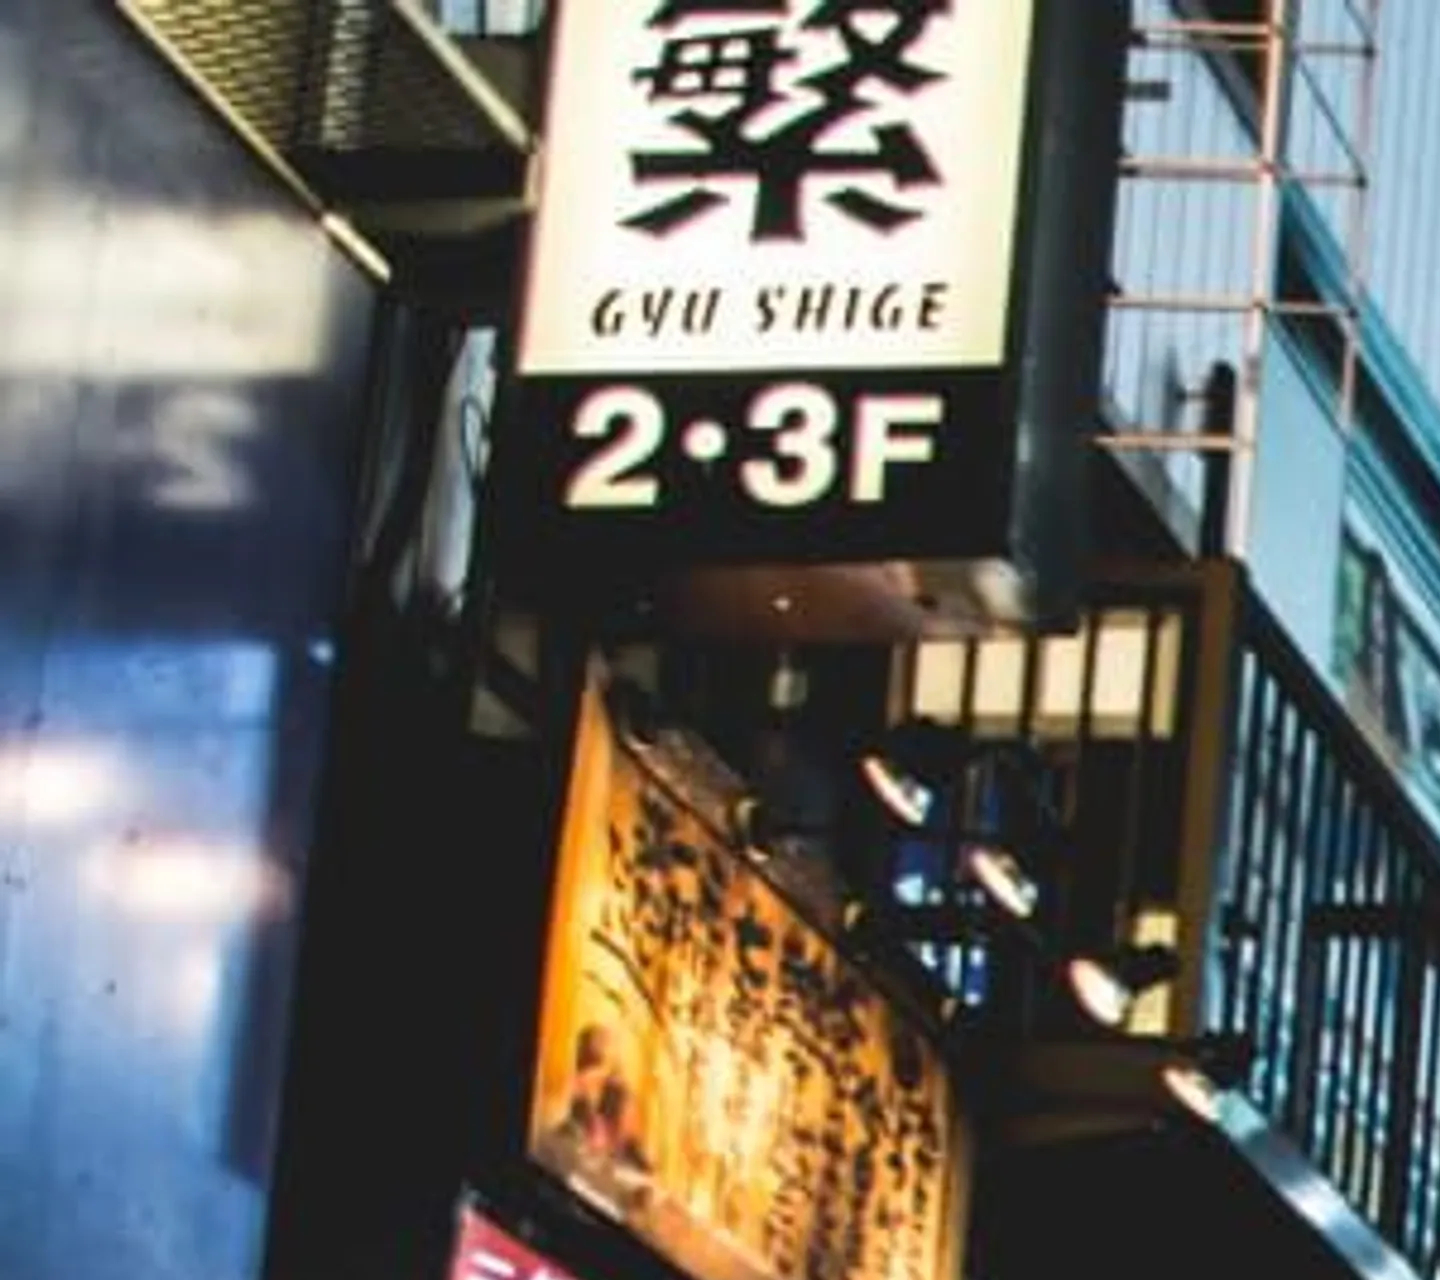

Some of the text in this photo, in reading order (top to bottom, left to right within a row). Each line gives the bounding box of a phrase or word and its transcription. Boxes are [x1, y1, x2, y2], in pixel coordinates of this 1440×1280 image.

[620, 0, 944, 241] 繁
[592, 281, 950, 337] GYU SHIGE
